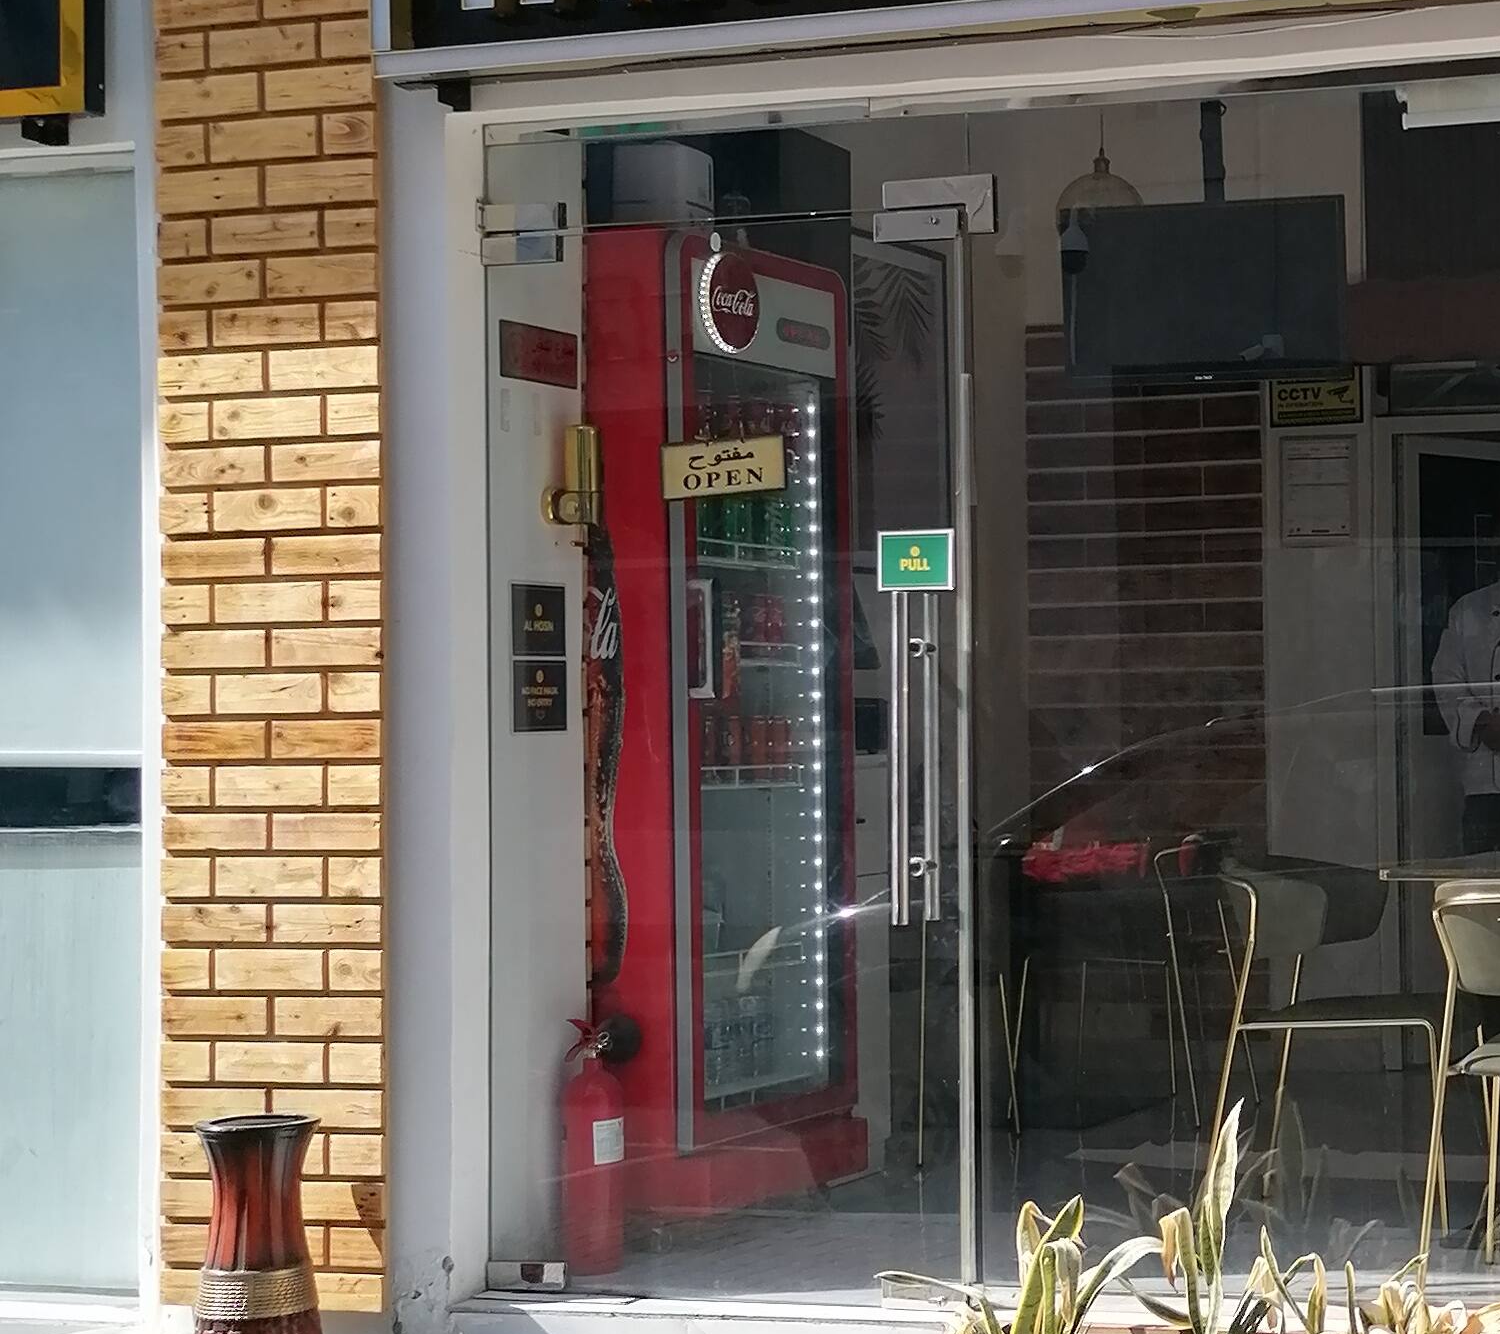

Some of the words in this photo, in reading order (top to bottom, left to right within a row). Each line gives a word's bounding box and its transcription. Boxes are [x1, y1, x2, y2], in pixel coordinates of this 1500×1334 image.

[1277, 386, 1322, 402] CCTV
[688, 447, 755, 470] مفتوح
[682, 466, 763, 491] OPEN
[899, 557, 931, 572] PULL
